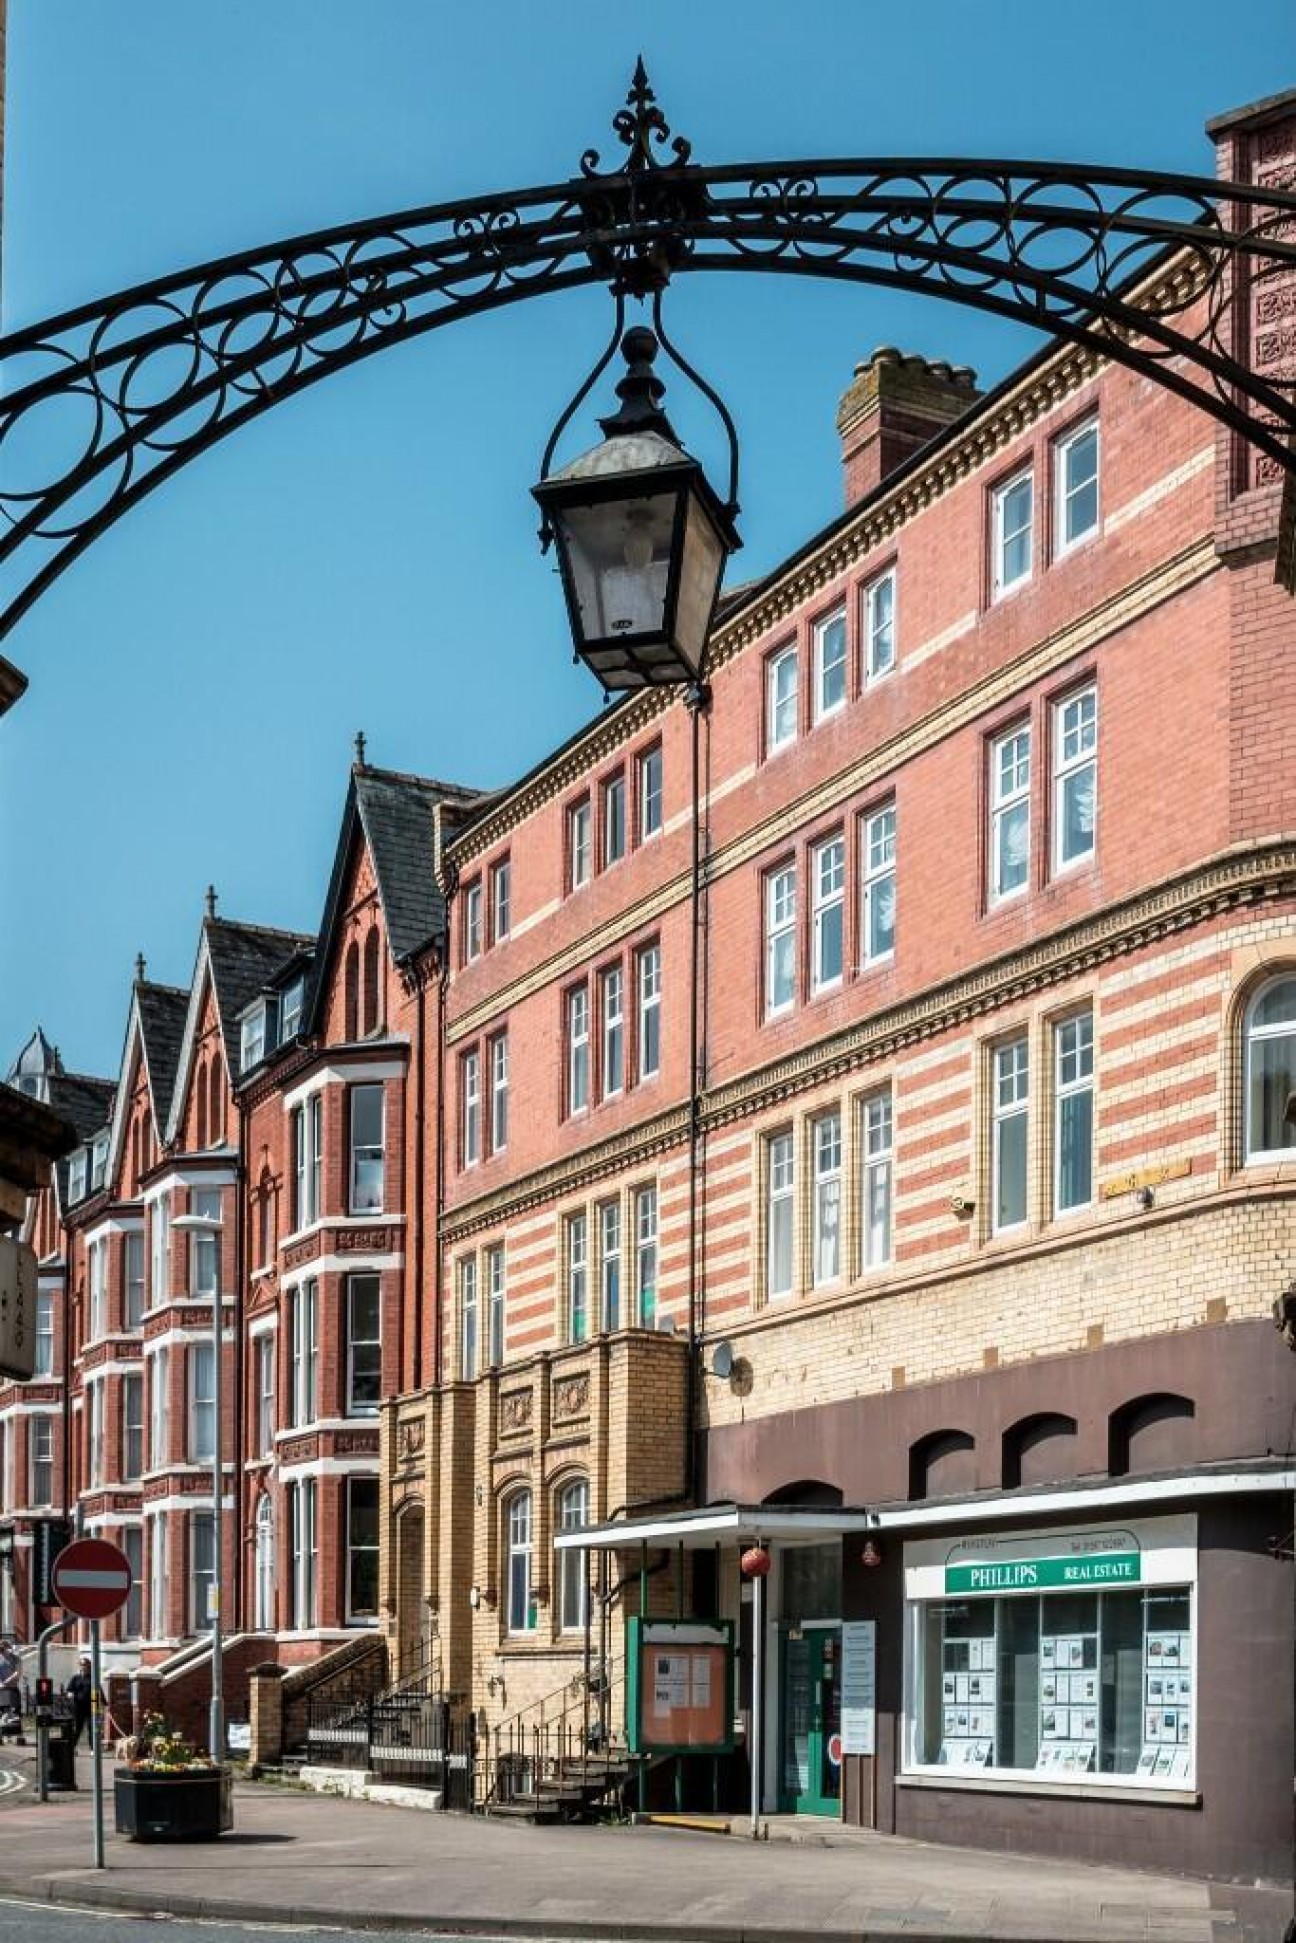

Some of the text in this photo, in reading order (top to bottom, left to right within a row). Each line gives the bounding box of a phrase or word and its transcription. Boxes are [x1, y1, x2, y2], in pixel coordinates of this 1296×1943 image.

[971, 1563, 1132, 1587] PHILLIPS REAL ESTATE
